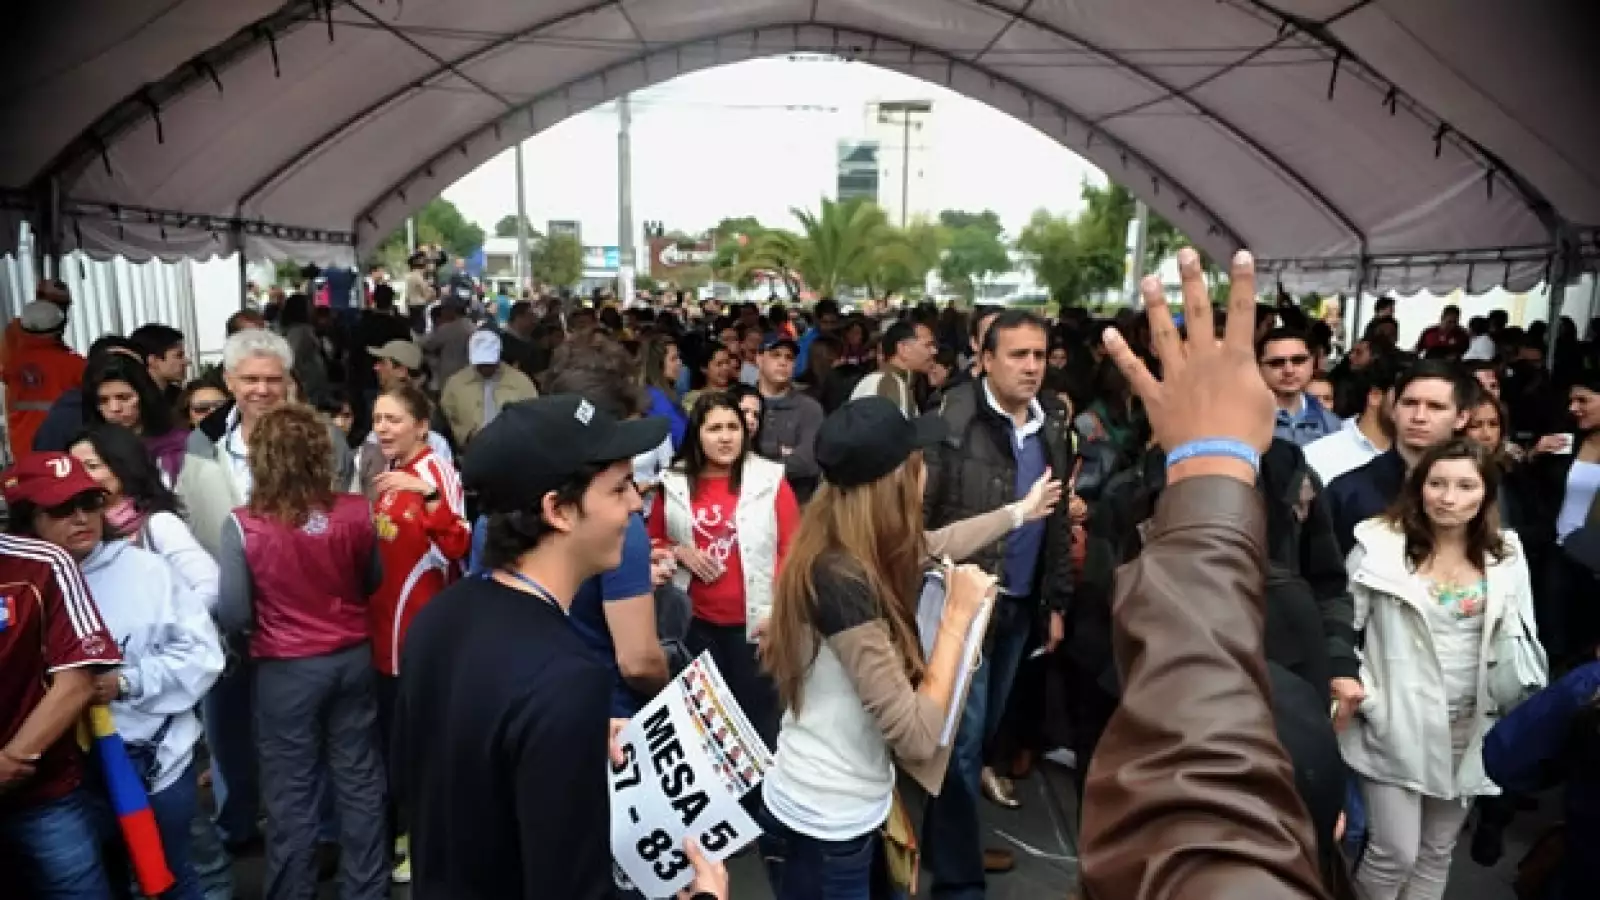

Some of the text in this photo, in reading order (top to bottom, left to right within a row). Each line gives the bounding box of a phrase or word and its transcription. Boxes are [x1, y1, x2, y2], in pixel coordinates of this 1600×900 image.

[643, 704, 711, 827] MESA
[699, 819, 739, 852] 5
[636, 828, 690, 881] 83
